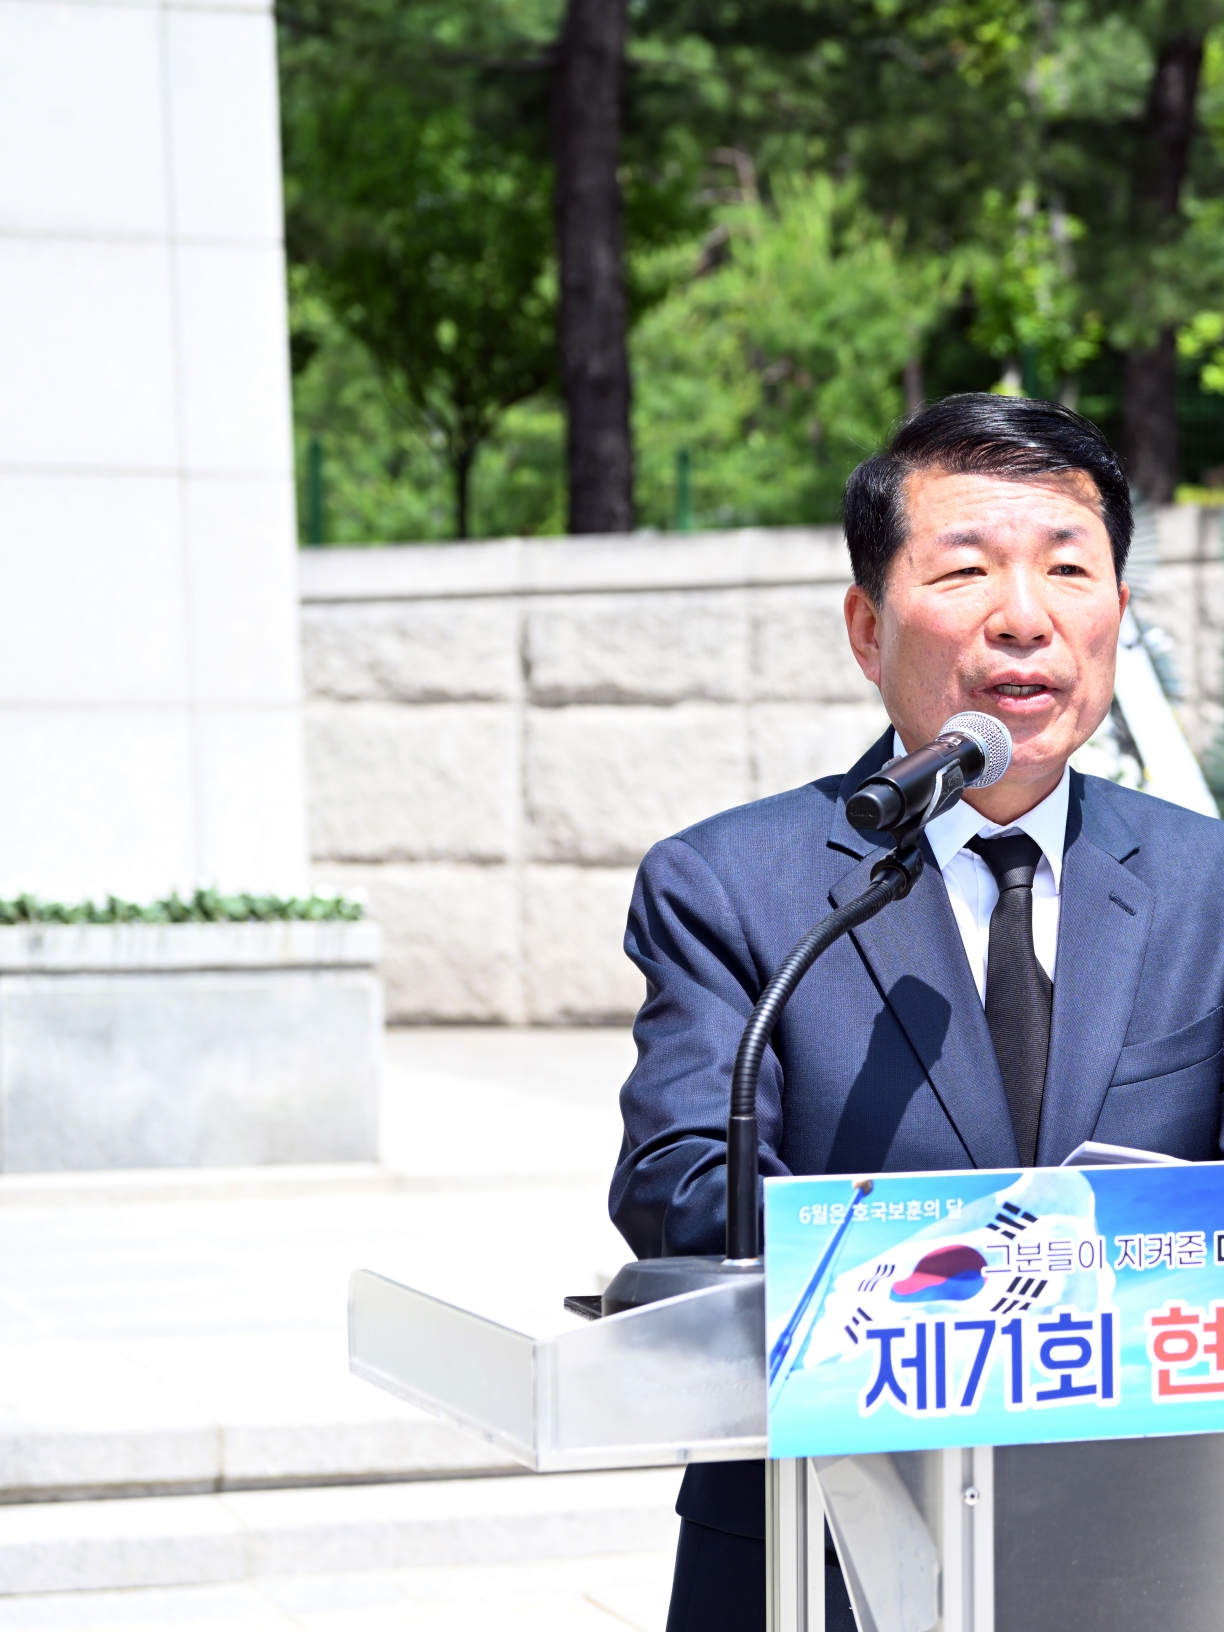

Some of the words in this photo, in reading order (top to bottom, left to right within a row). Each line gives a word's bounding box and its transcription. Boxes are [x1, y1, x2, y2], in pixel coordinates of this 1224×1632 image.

[798, 1203, 846, 1225] 6월은
[851, 1199, 940, 1223] 호국보훈의
[945, 1198, 964, 1219] 달
[984, 1238, 1104, 1275] 그분들이
[1116, 1231, 1204, 1269] 지켜준
[865, 1311, 1114, 1411] 제71회
